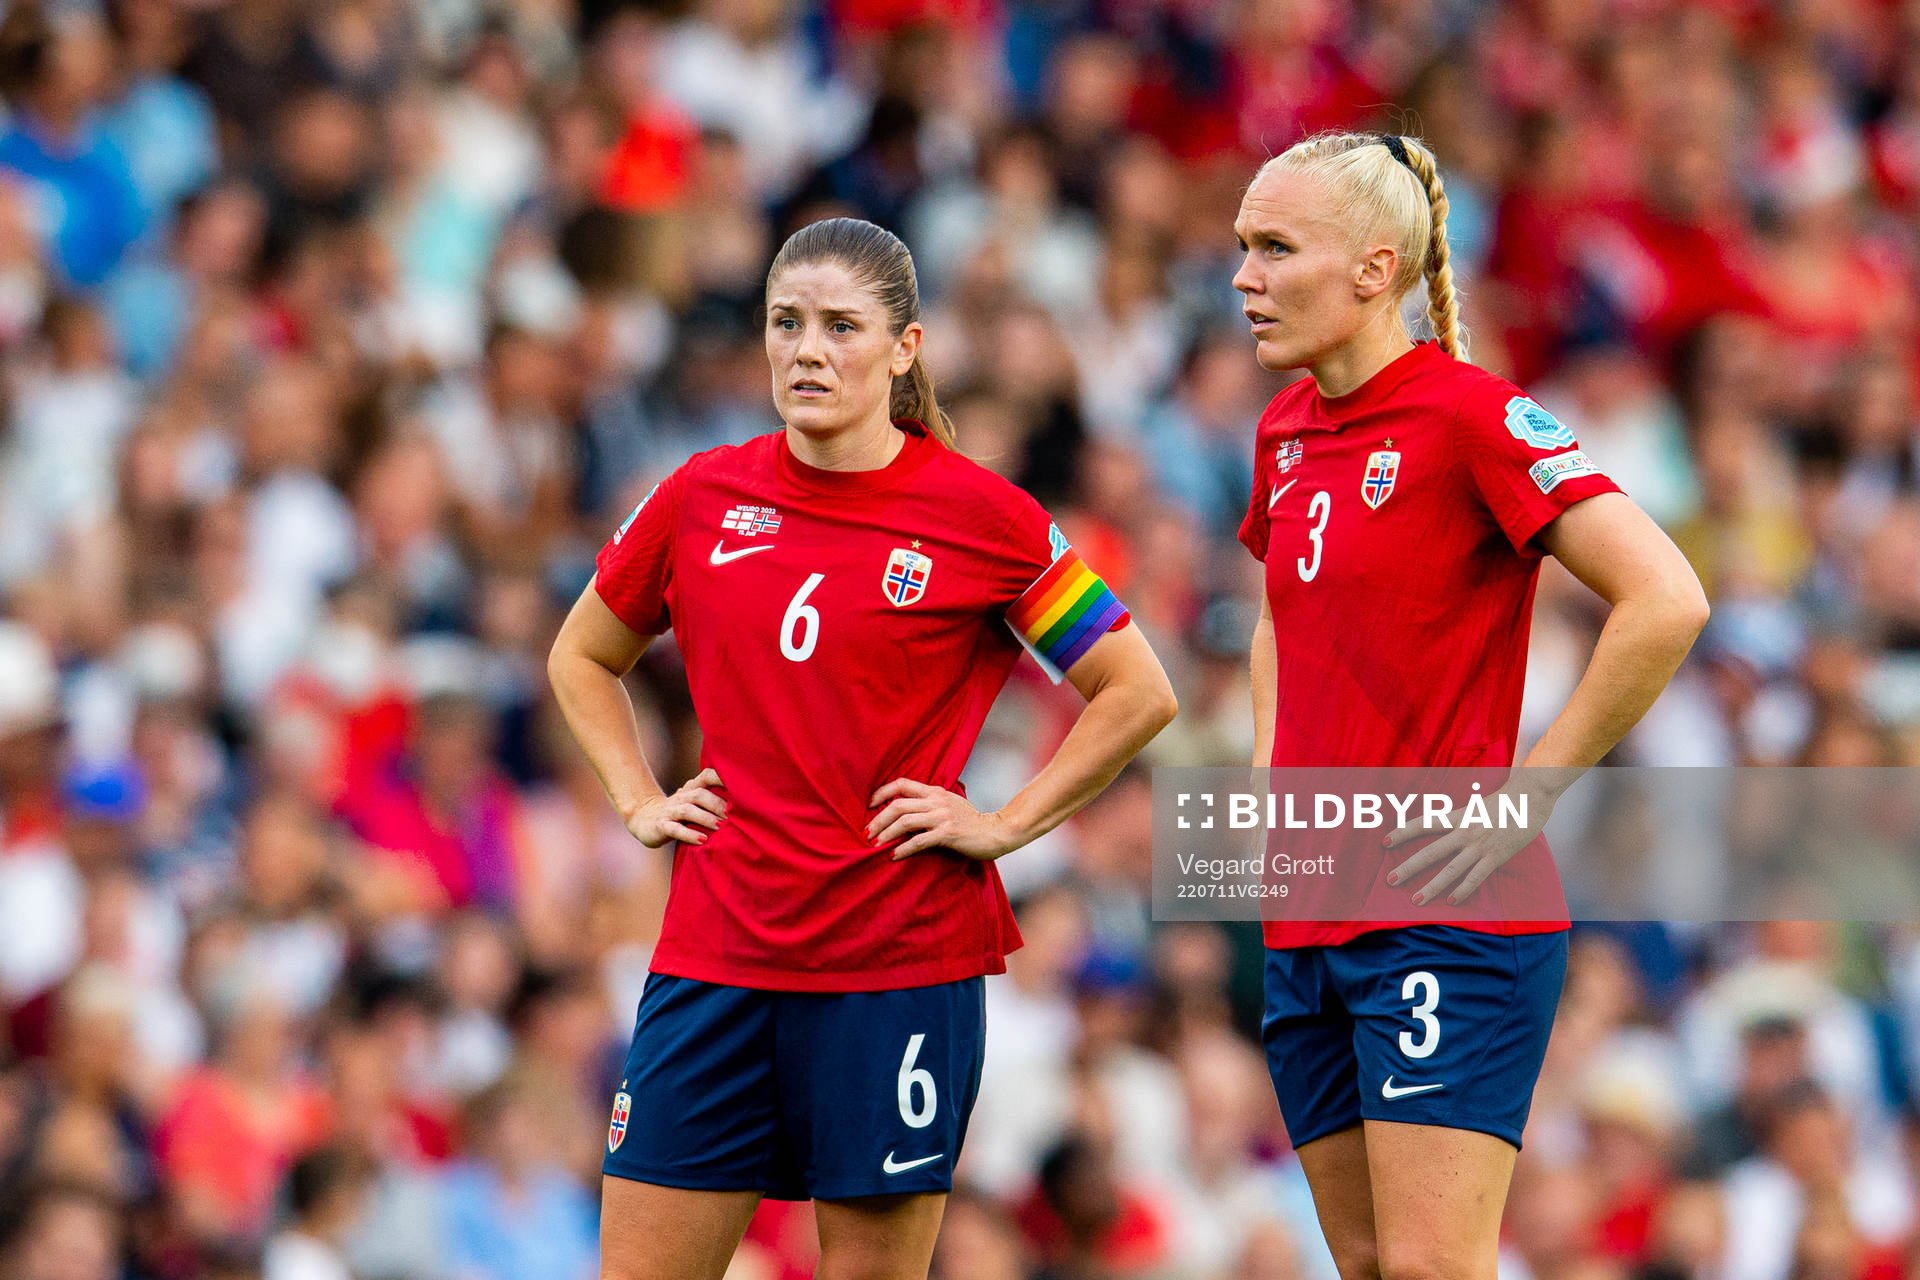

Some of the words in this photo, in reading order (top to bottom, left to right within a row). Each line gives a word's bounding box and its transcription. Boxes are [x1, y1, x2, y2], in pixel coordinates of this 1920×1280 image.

[736, 504, 760, 513] WEURO
[760, 506, 776, 515] 2022
[1297, 490, 1331, 583] 3
[779, 572, 826, 662] 6
[1398, 971, 1440, 1058] 3
[898, 1033, 937, 1128] 6
